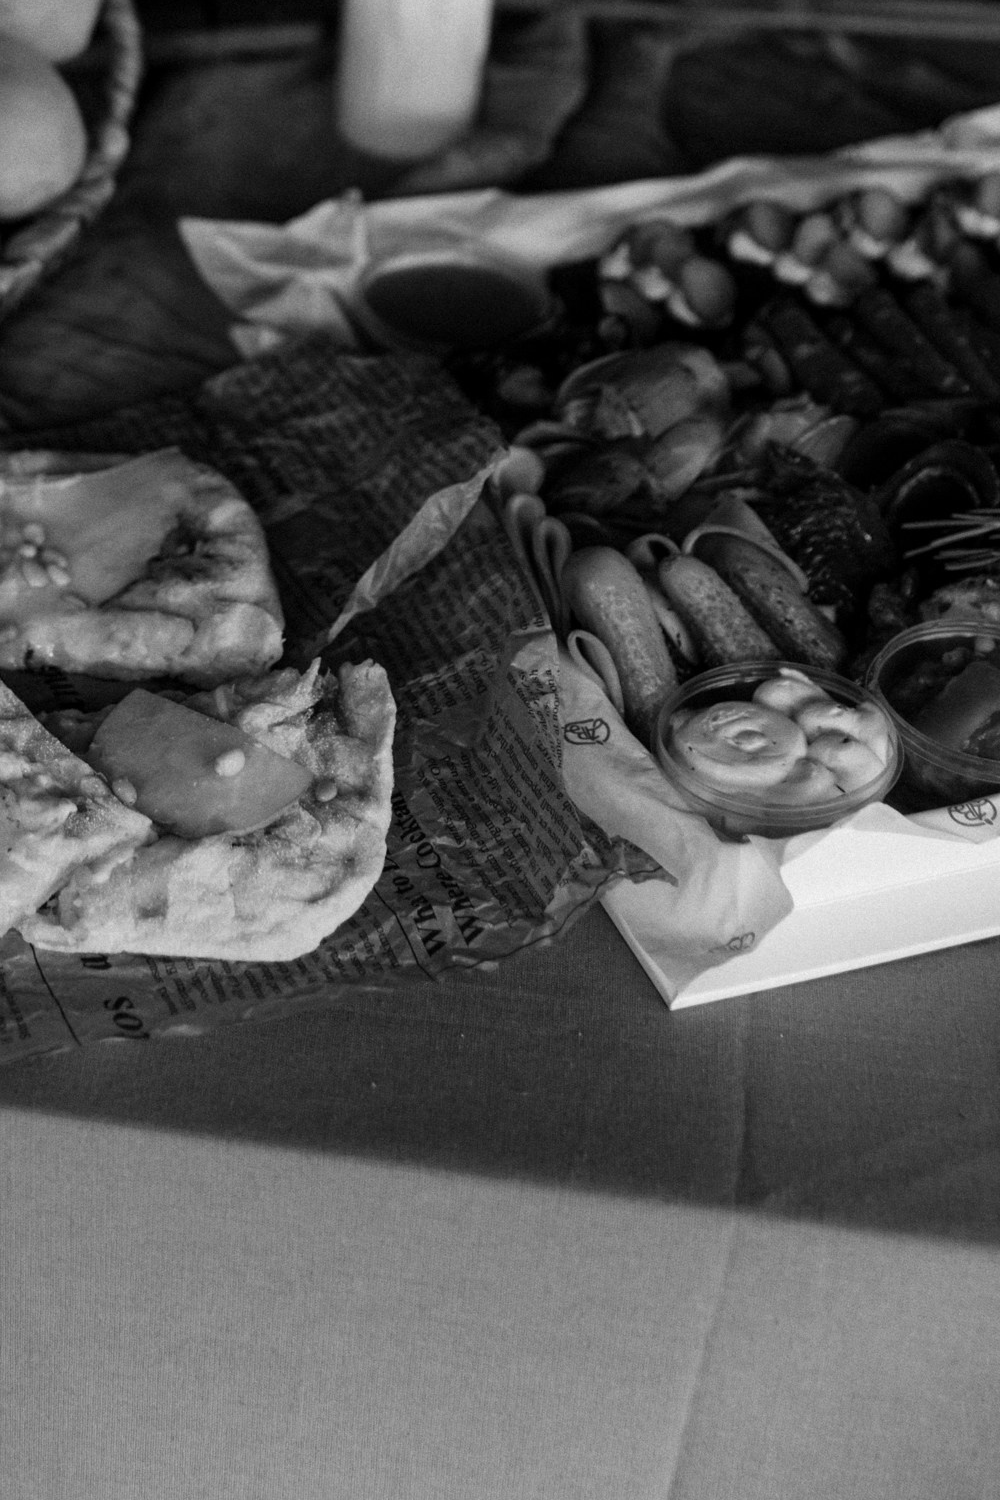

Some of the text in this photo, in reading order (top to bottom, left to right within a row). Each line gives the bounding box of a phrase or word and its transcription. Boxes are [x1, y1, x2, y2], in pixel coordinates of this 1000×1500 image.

[440, 754, 461, 779] used
[534, 769, 557, 794] drink
[520, 795, 540, 819] more
[500, 845, 524, 876] which
[391, 872, 416, 895] to
[432, 871, 486, 945] Where
[411, 892, 450, 955] Wha
